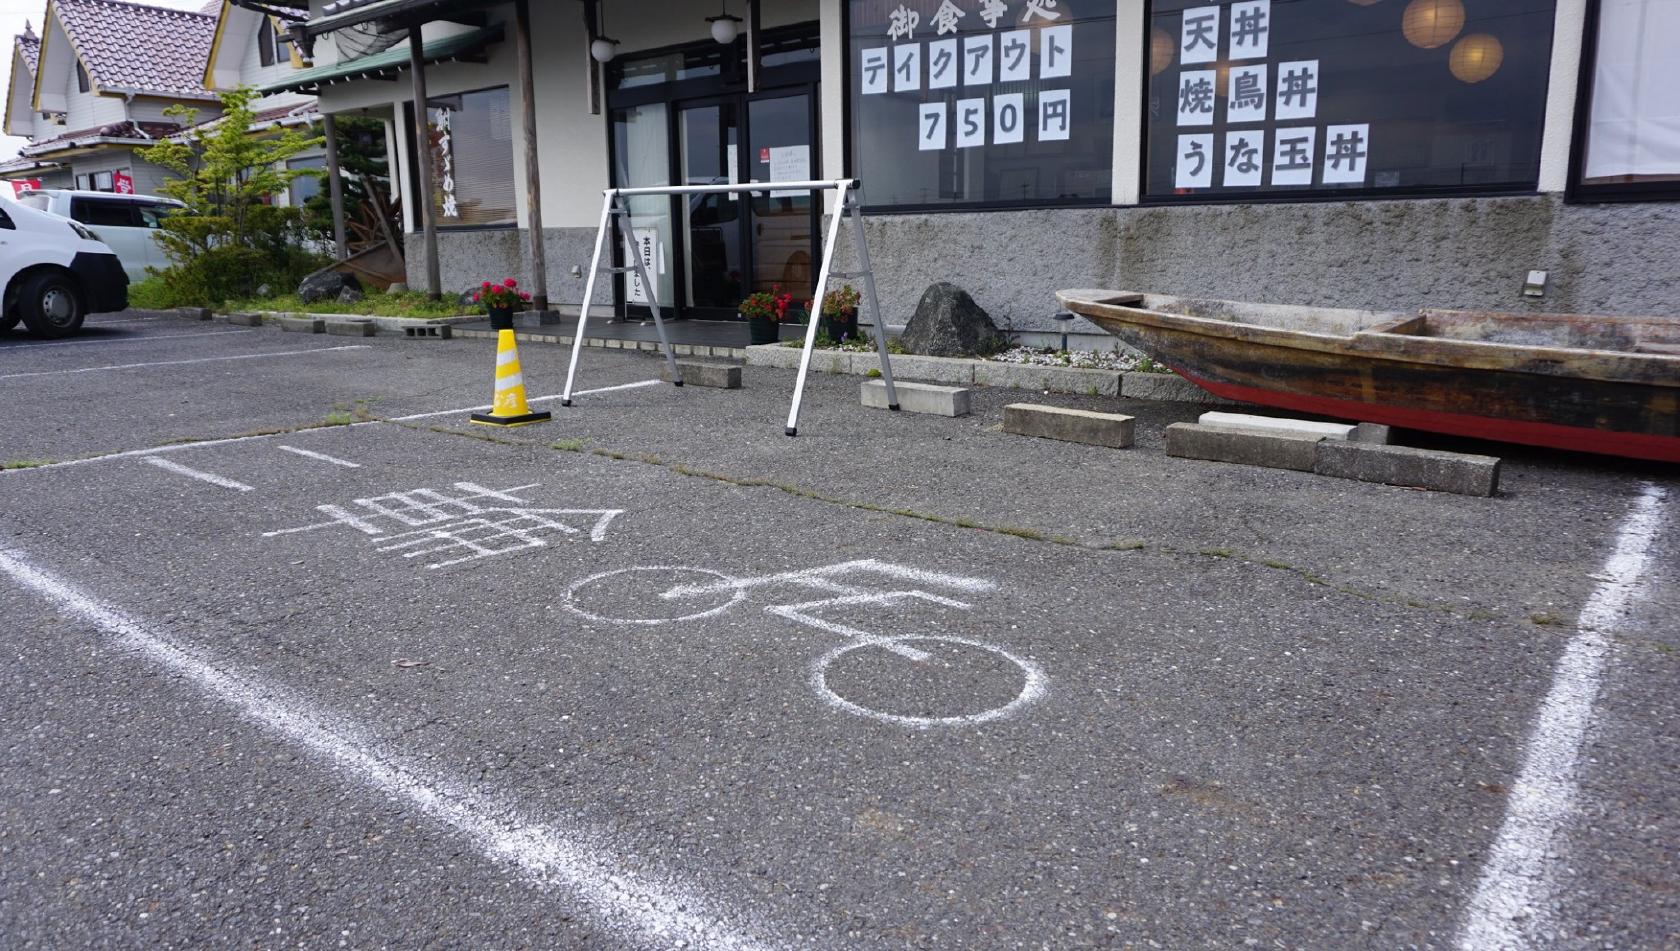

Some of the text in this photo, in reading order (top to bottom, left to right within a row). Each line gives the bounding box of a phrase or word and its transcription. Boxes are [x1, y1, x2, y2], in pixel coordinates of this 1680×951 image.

[1183, 6, 1268, 52] 天丼
[863, 34, 1065, 85] テイクアウト
[1179, 67, 1317, 114] 焼鳥丼
[923, 98, 1067, 140] 750円
[1184, 130, 1367, 178] うな玉丼
